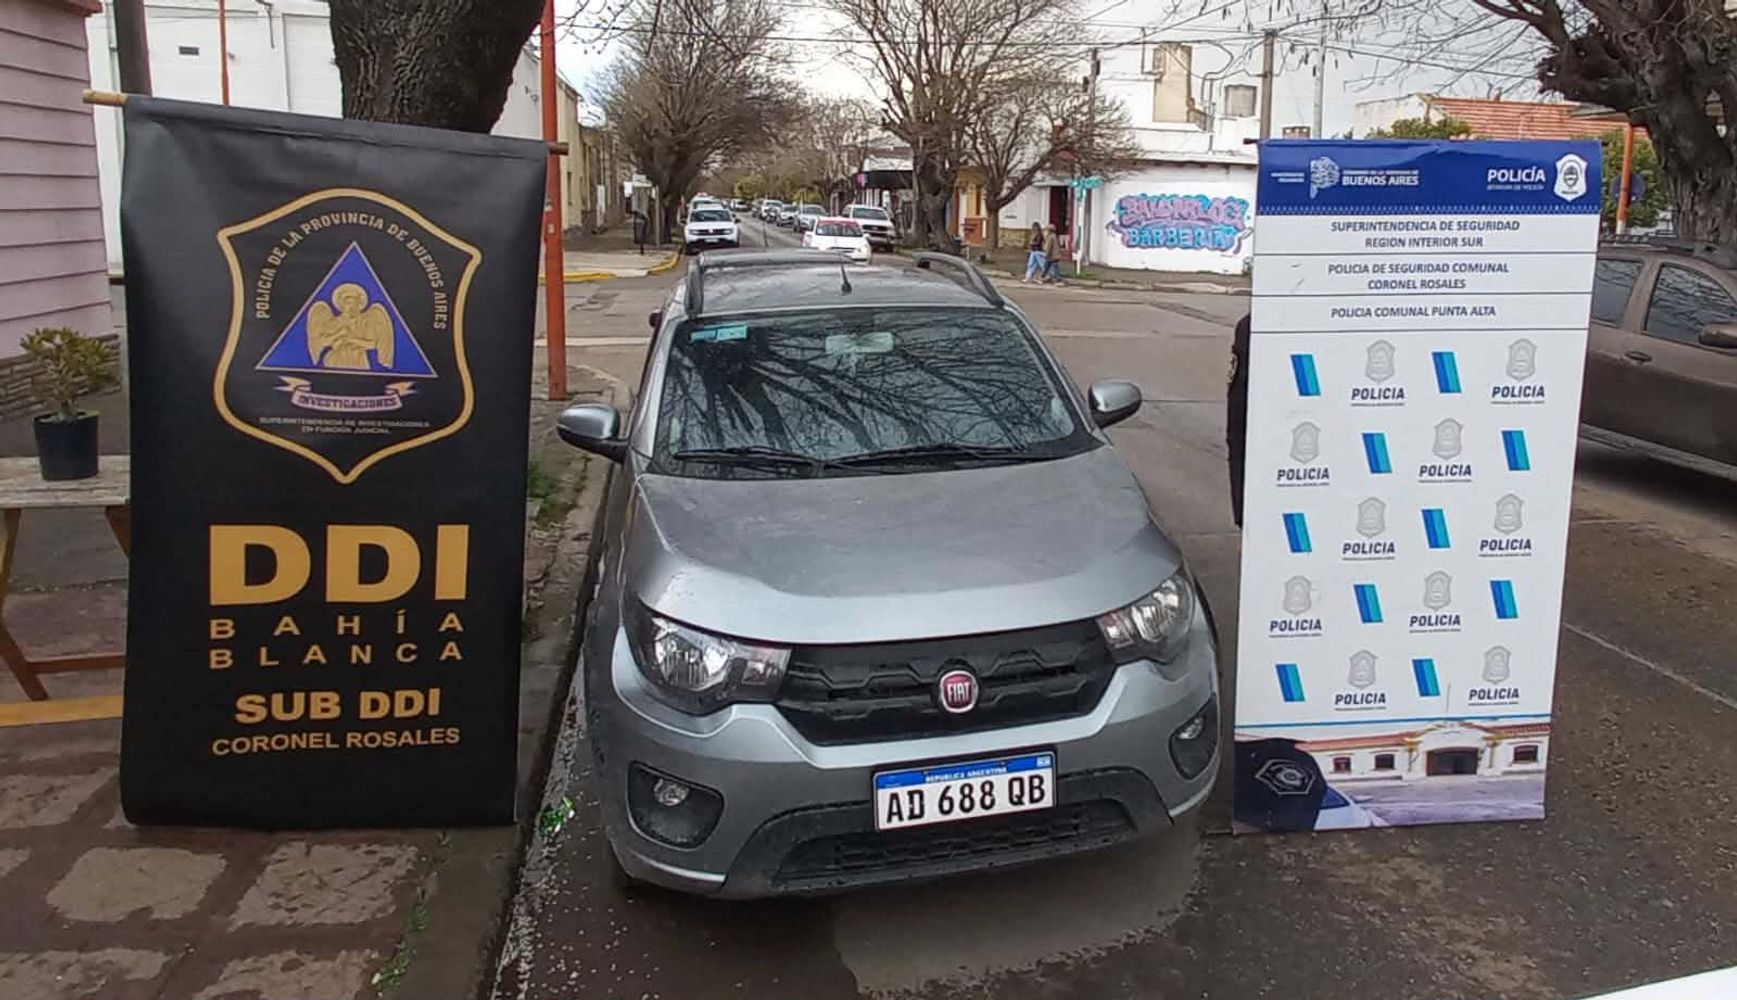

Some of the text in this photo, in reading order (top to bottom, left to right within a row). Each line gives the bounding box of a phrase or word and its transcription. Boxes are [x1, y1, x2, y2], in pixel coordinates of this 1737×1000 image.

[1342, 175, 1419, 186] BUENOS AIRES
[1488, 165, 1546, 182] POLICÍA
[1330, 220, 1520, 232] SUPERINTENDENCIA DE SEGURIDAD
[1365, 237, 1484, 248] REGION INTERIOR SUR
[255, 212, 448, 330] POLICIA DE LA PROVINCIA DE BUENOS AIRES
[1328, 263, 1509, 274] POLICIA DE SEGURIDAD COMUNAL
[1368, 279, 1466, 289] CORONEL ROSALES
[1331, 306, 1496, 318] POLICIA COMUNAL PUNTA ALTA
[1351, 387, 1406, 401] POLICIA
[1491, 384, 1546, 399] POLICIA
[1277, 468, 1330, 482] POLICIA
[1418, 464, 1472, 478] POLICIA
[1342, 542, 1396, 555] POLICIA
[1479, 538, 1532, 552] POLICIA
[209, 524, 469, 606] DDI
[209, 609, 464, 640] BAHÍA
[1269, 619, 1322, 632] POLICIA
[1409, 614, 1461, 628] POLICIA
[209, 641, 463, 669] BLANCA
[947, 682, 970, 702] FIAT
[1468, 688, 1520, 701] POLICIA
[235, 688, 441, 724] SUB DDI
[1334, 693, 1387, 706] POLICIA
[212, 727, 461, 756] CORONEL ROSALES
[967, 766, 1007, 778] ARGENTINA
[886, 774, 1046, 824] AD 688 QB
